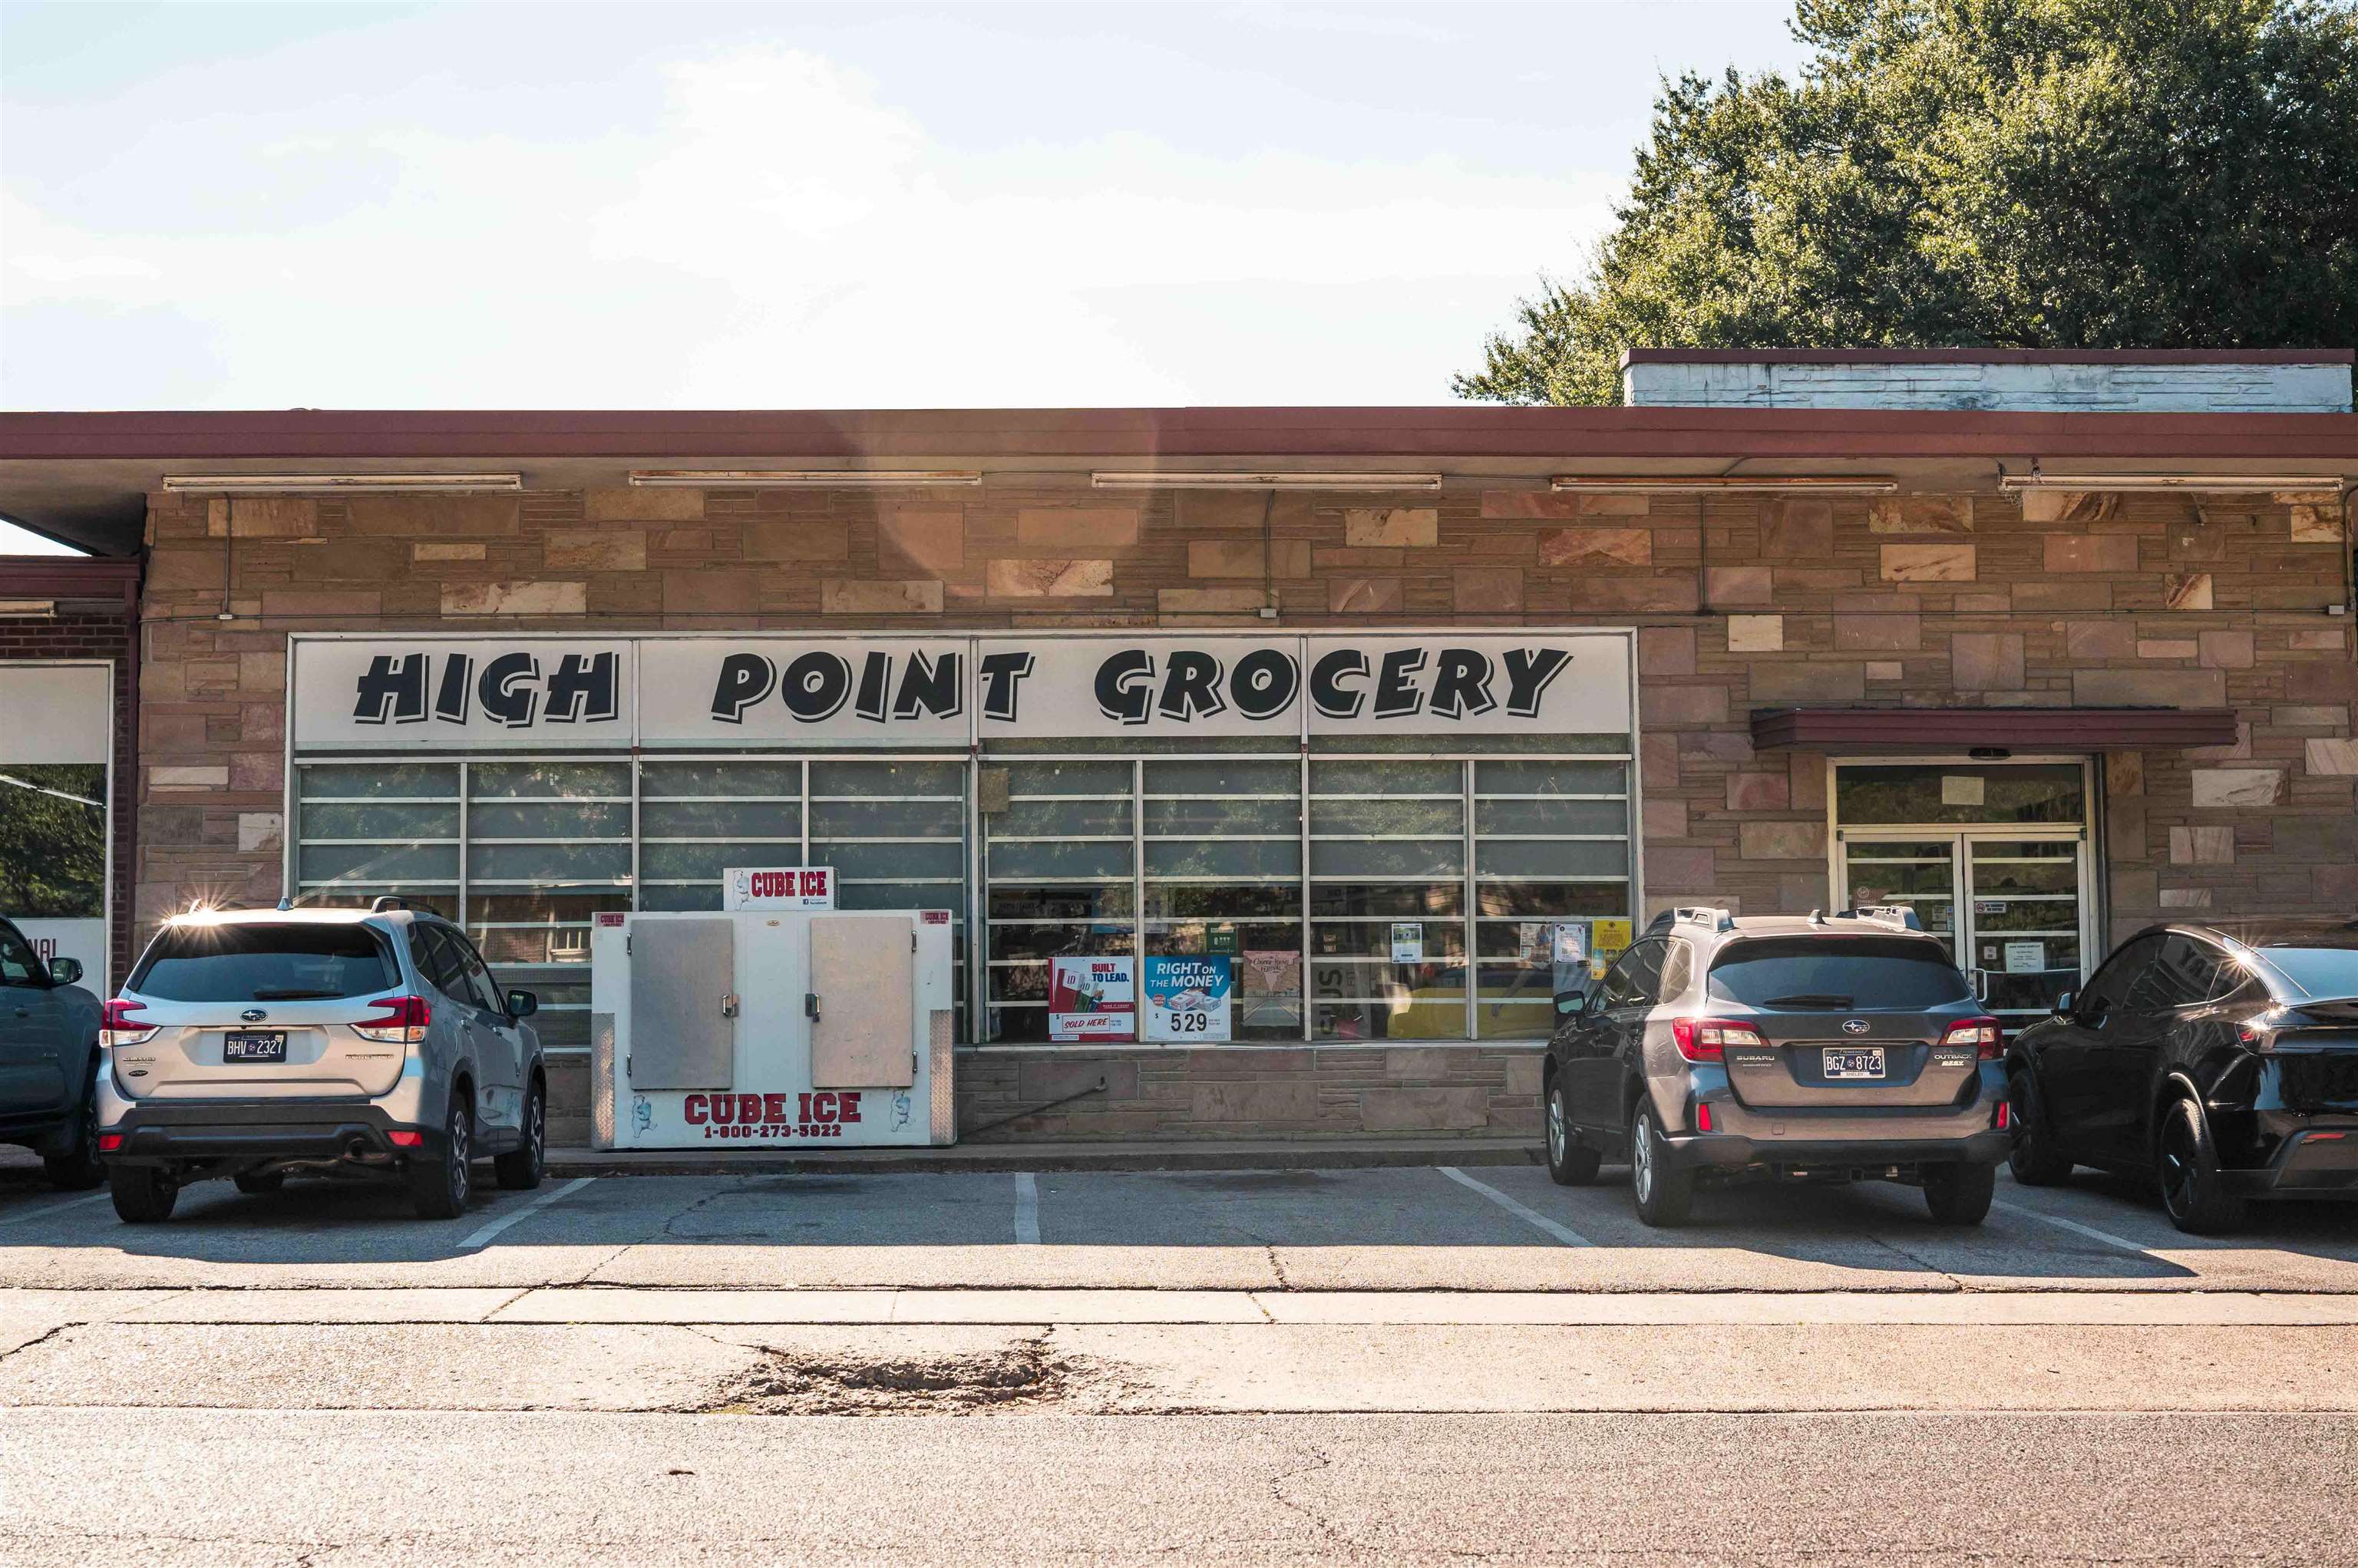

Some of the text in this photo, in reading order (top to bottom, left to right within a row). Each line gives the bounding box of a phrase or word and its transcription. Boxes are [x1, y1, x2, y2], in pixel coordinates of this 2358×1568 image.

[353, 647, 1574, 729] HIGH POINT GROCERY
[751, 871, 827, 897] CUBE ICE
[1091, 963, 1116, 972] BUILT
[1156, 962, 1217, 975] RIGHT ON
[1091, 973, 1130, 982] TO LEAD.
[1150, 975, 1224, 988] THE MONEY
[1064, 1020, 1085, 1028] SOLD
[1086, 1018, 1108, 1027] HERE
[227, 1040, 283, 1055] BHV 2327
[1826, 1055, 1882, 1070] BGZ 8723
[684, 1092, 861, 1124] CUBE ICE
